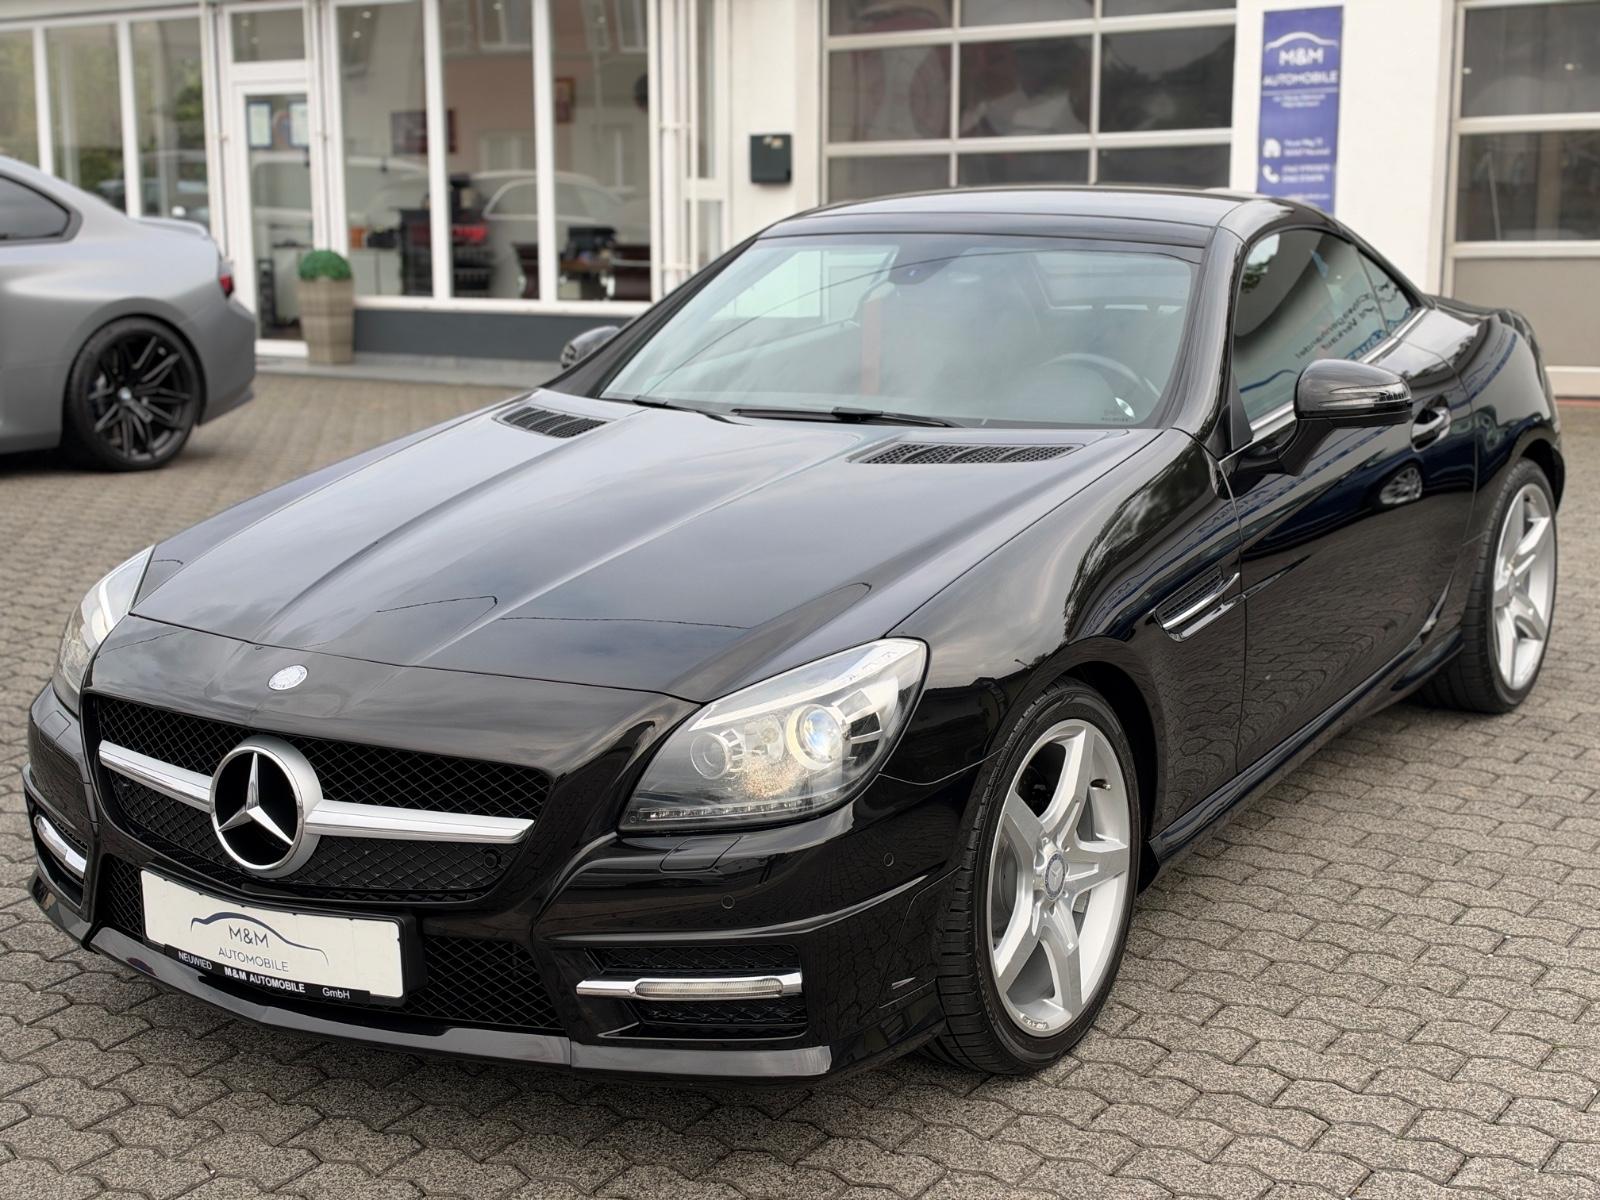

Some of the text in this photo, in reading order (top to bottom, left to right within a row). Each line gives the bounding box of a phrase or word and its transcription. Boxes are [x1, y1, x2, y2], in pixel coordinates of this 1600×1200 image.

[1278, 47, 1324, 66] M&M
[1263, 70, 1338, 86] AUTOMOBILE
[228, 925, 269, 948] M&M
[178, 951, 213, 970] NEUWIED
[218, 946, 289, 972] AUTOMOBILE
[224, 966, 350, 1000] M&M AUTOMOBILE GmbH
